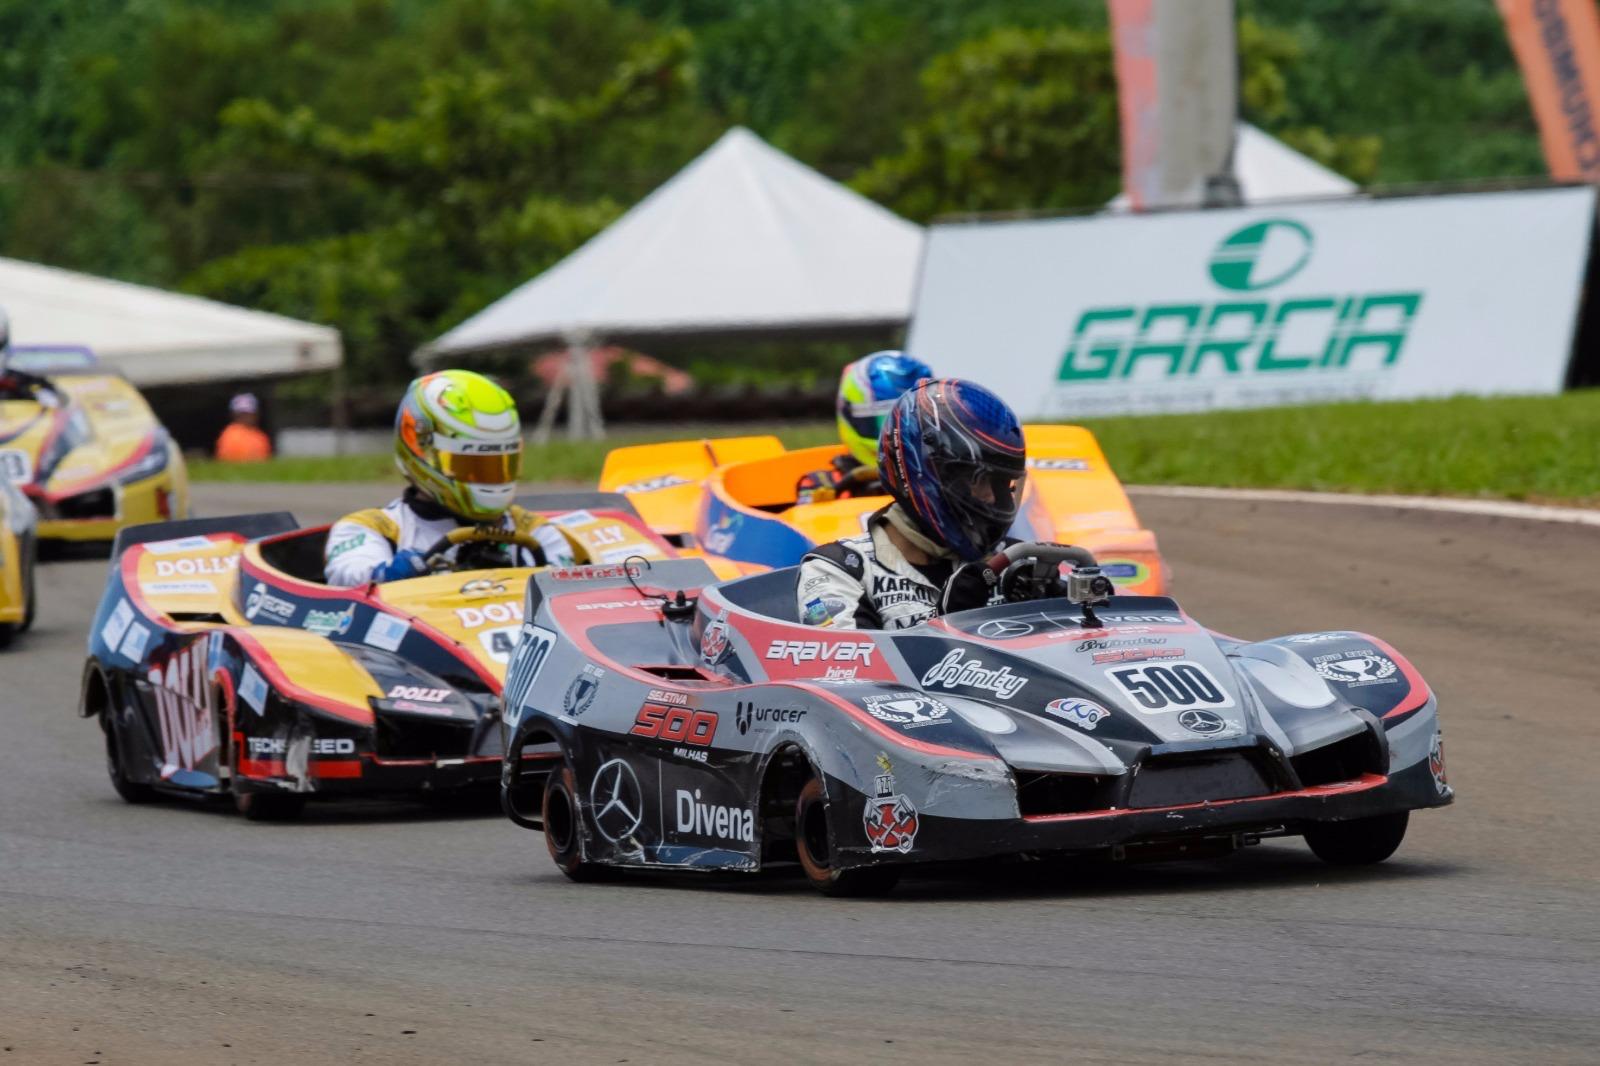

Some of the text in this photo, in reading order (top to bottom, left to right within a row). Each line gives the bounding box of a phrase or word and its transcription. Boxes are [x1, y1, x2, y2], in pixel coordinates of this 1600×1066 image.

[1057, 292, 1423, 381] GARCIA
[154, 555, 240, 577] DOLLY
[387, 685, 451, 702] DOLLY
[647, 690, 688, 705] SELETIVA
[1111, 664, 1226, 709] 500
[630, 702, 719, 747] 500
[755, 704, 808, 723] uracer
[673, 747, 709, 763] MILHAS
[676, 789, 754, 842] Divena
